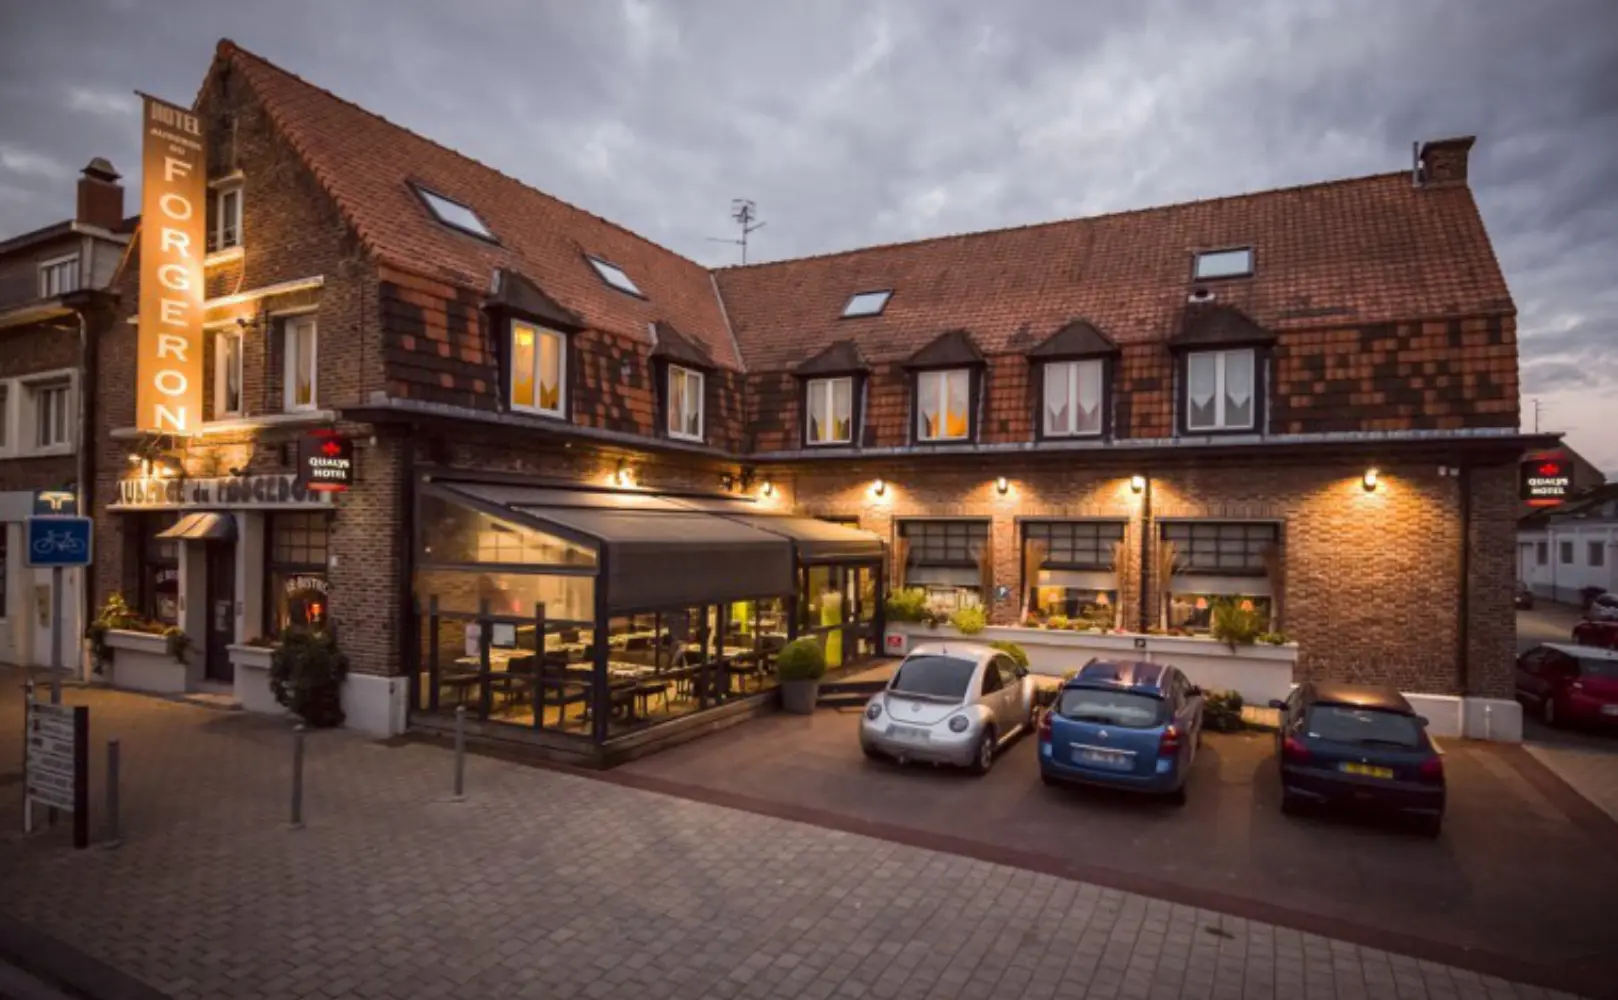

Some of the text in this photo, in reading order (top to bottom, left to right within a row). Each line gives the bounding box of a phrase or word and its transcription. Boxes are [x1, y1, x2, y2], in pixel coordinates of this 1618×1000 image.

[151, 101, 201, 136] HOTEL
[154, 156, 193, 430] FORGERON
[309, 456, 350, 469] QUALYS
[313, 468, 347, 480] HOTEL
[1531, 487, 1566, 495] HOTEL
